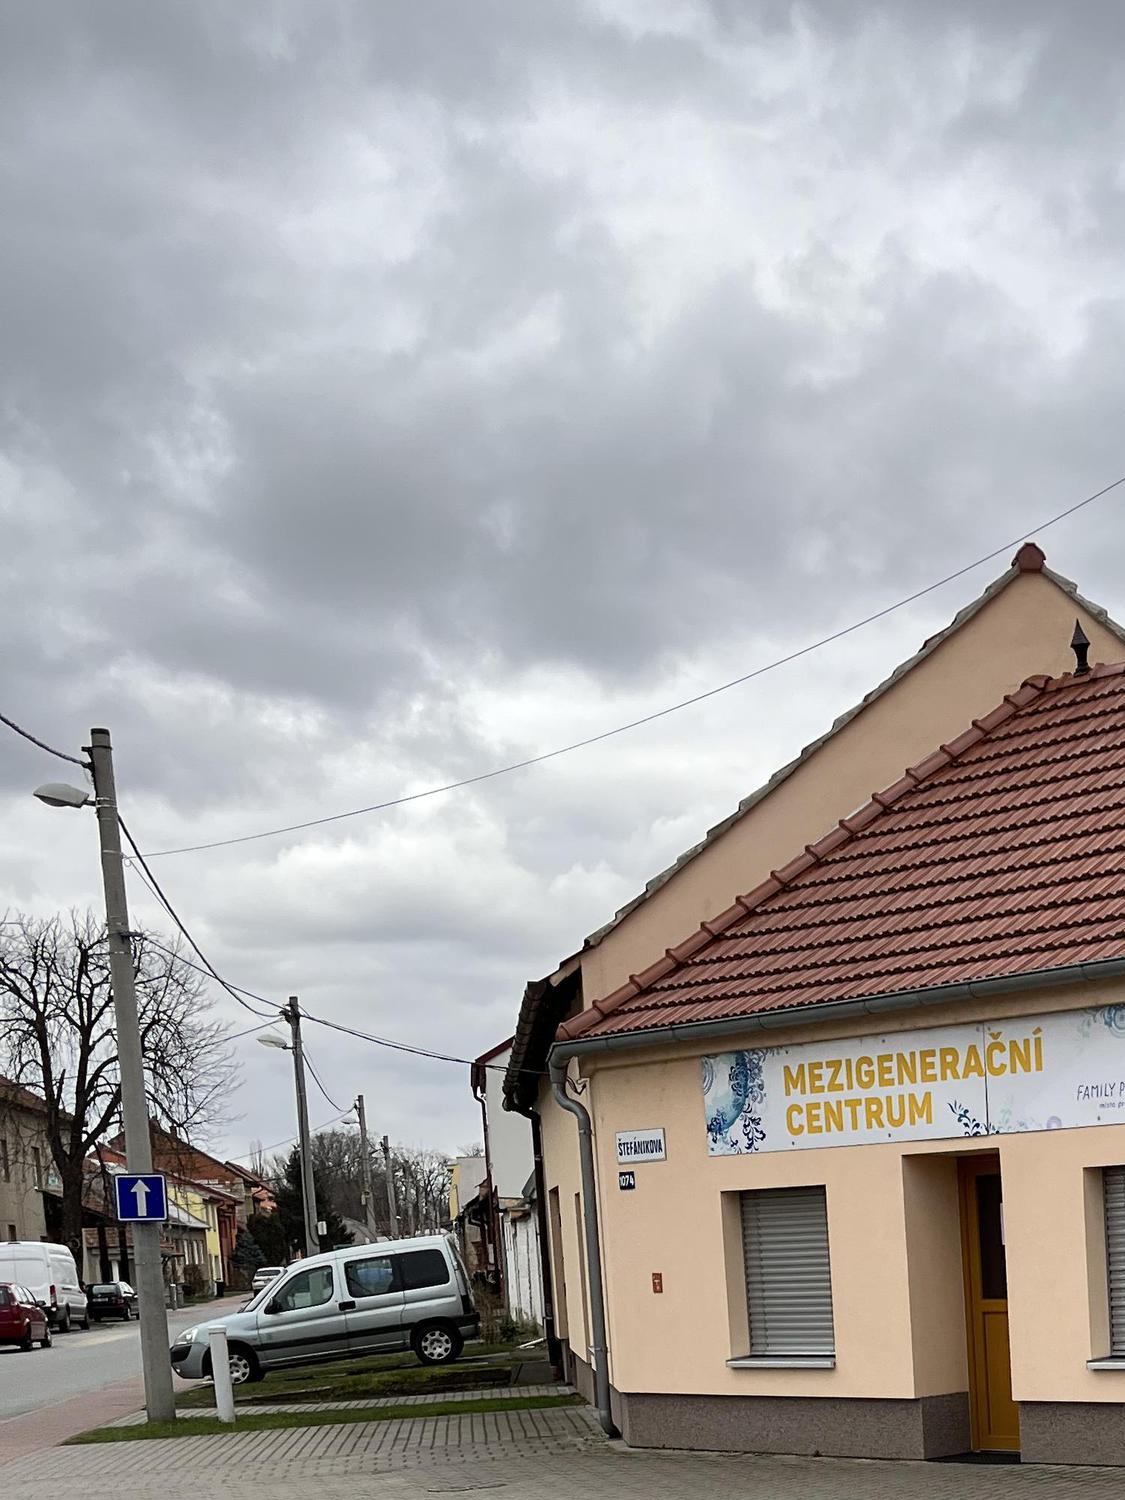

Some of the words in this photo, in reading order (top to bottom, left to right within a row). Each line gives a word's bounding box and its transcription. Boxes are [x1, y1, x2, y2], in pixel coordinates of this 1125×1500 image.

[783, 1027, 1043, 1096] MEZIGENERAČNÍ
[1077, 1083, 1116, 1100] FAMILY
[786, 1091, 933, 1136] CENTRUM
[618, 1136, 663, 1156] ŠTEFÁNIKOVA
